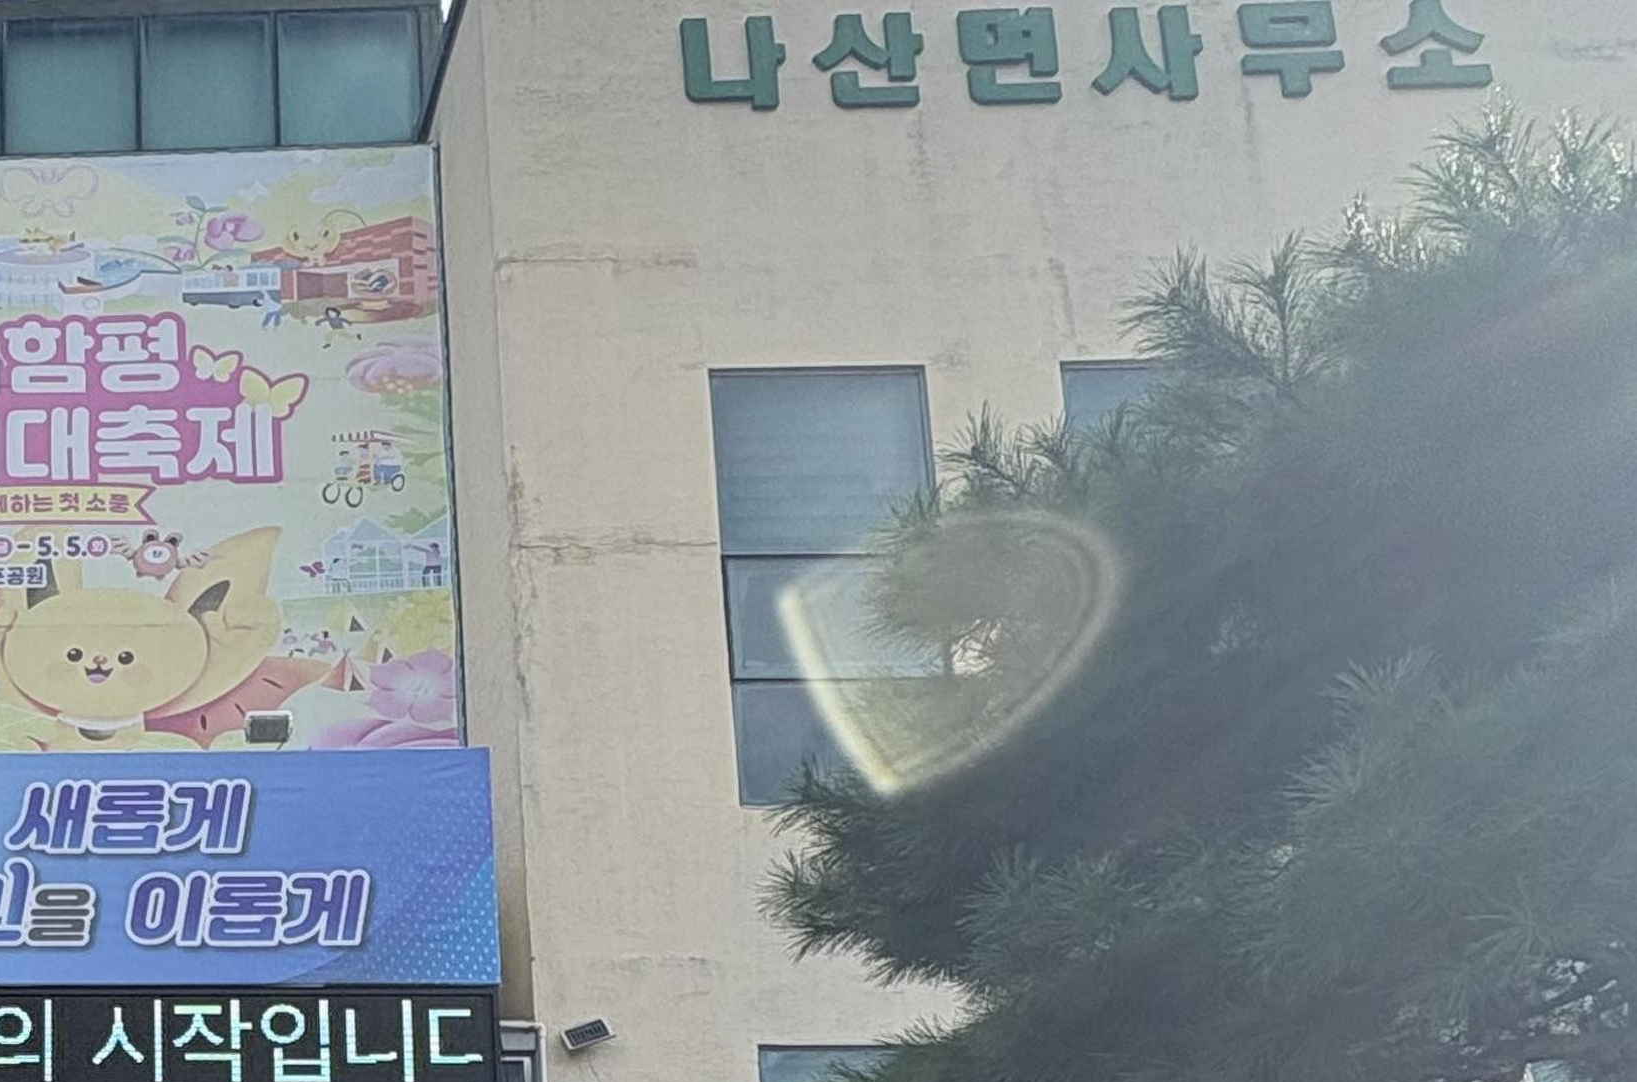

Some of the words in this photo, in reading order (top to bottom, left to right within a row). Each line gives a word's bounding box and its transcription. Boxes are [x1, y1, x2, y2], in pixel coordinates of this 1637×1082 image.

[680, 0, 1494, 110] 나산면사무소
[4, 318, 180, 393] 함평
[59, 493, 80, 513] 첫
[86, 493, 131, 514] 소풍
[37, 536, 59, 557] 5.
[6, 780, 248, 850] 새롭게
[126, 872, 368, 946] 이롭게
